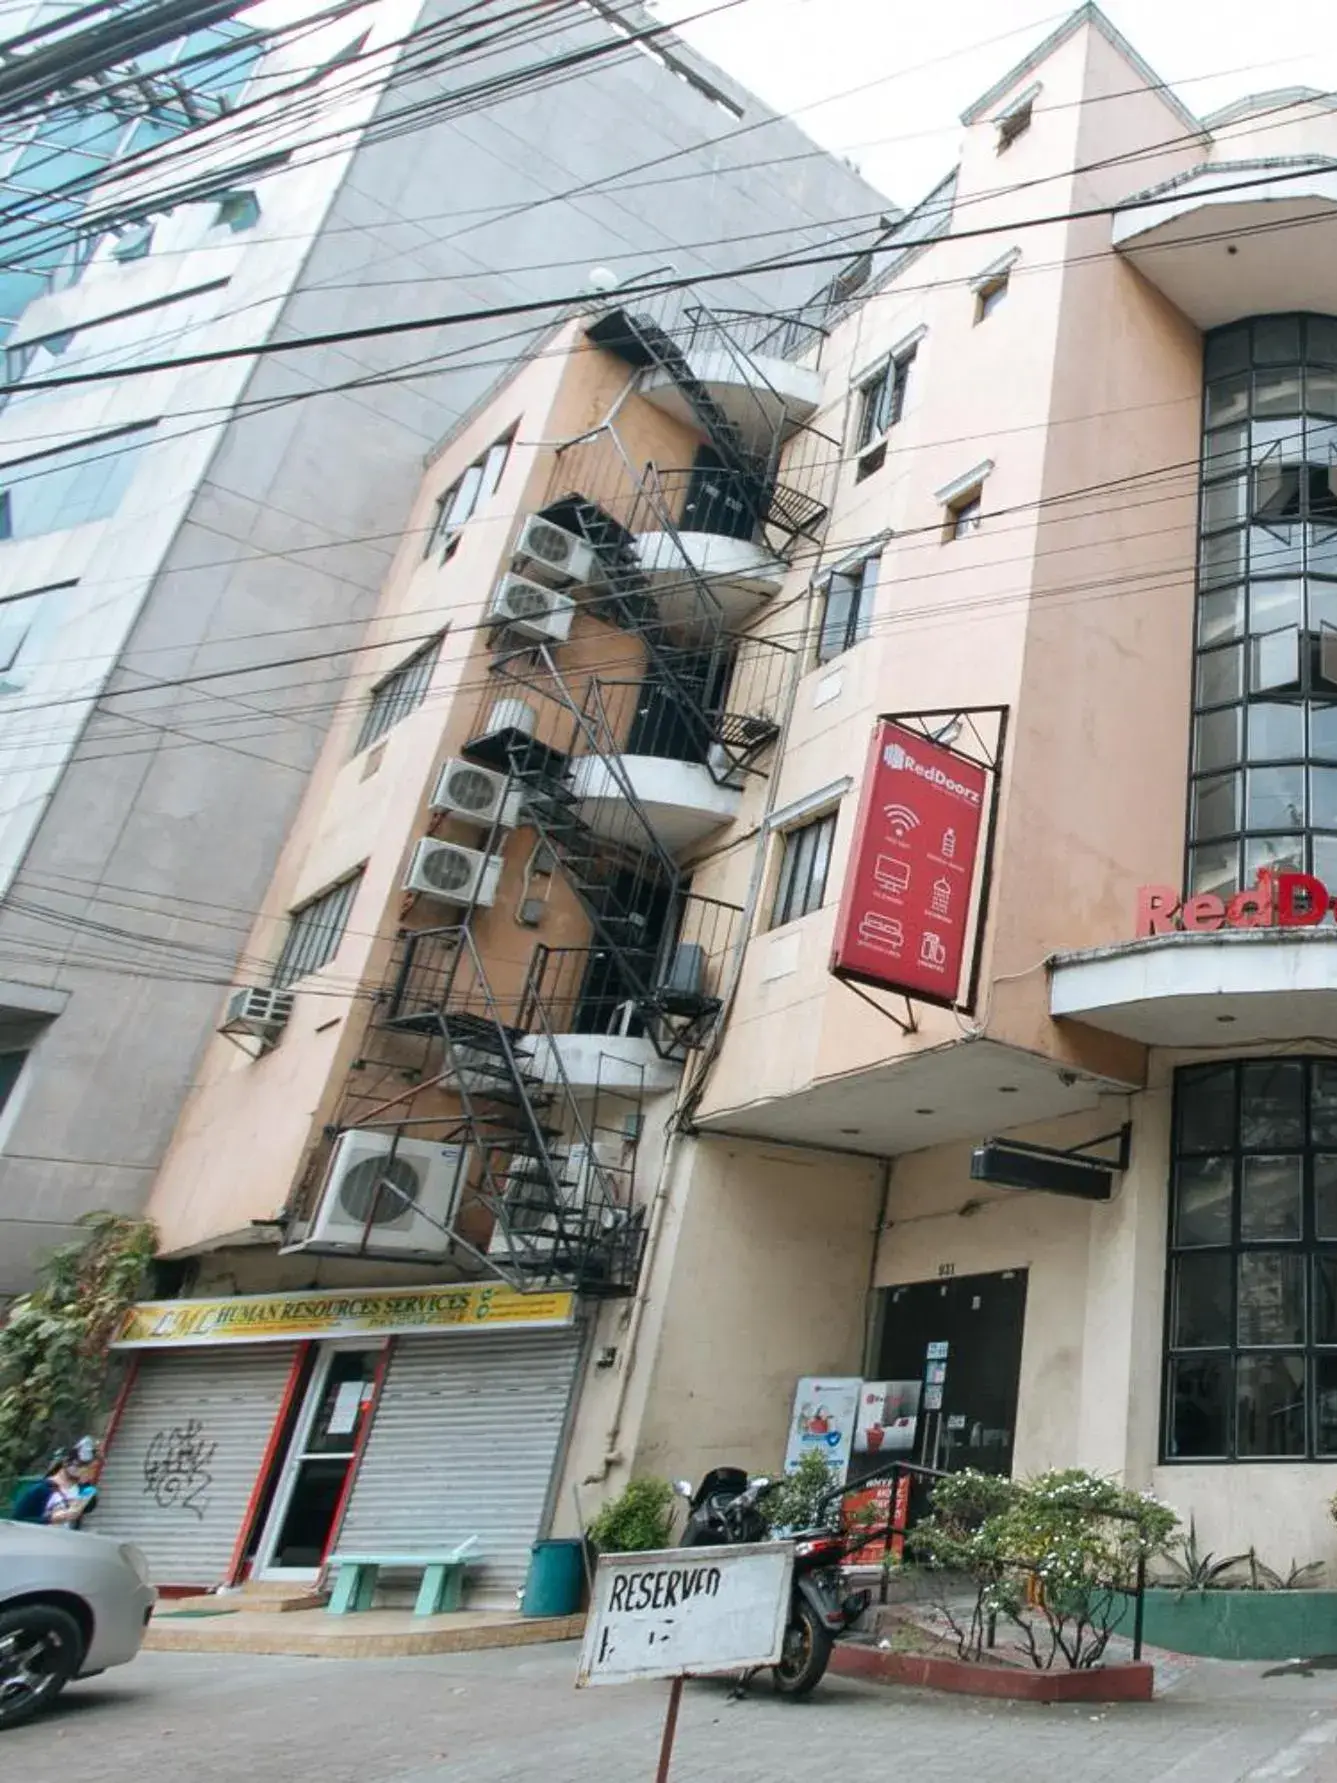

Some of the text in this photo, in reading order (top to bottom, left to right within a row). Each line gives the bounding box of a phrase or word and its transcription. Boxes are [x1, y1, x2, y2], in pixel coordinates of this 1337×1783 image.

[904, 755, 982, 804] RedDoorz
[217, 1302, 282, 1323] HUMAN
[282, 1298, 381, 1319] RESOURCES
[385, 1292, 472, 1314] SERVICES
